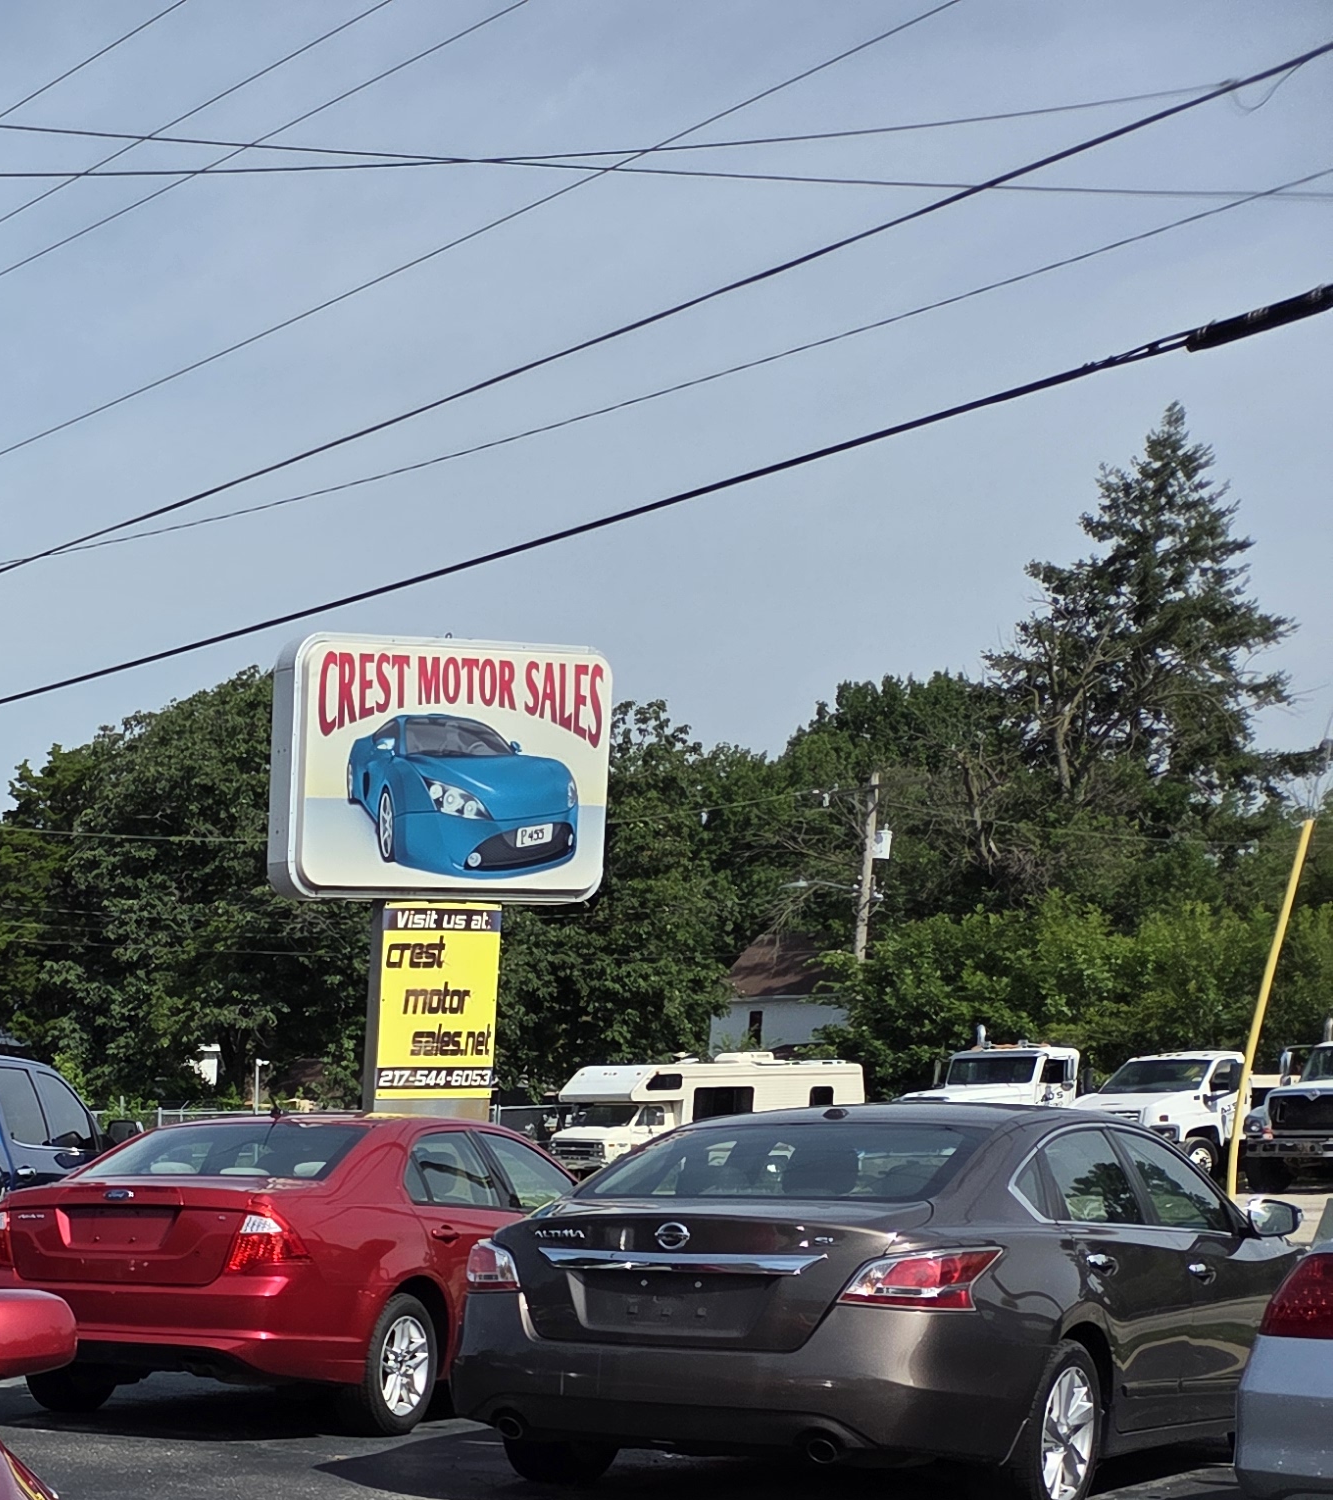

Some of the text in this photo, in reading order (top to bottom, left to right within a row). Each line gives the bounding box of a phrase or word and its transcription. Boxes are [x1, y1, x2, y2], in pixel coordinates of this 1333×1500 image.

[318, 651, 604, 749] CREST MOTOR SALES
[397, 911, 438, 929] Visit
[442, 914, 467, 929] us
[386, 935, 446, 969] crest
[402, 981, 471, 1015] motor
[379, 1070, 492, 1087] 217-544-6053
